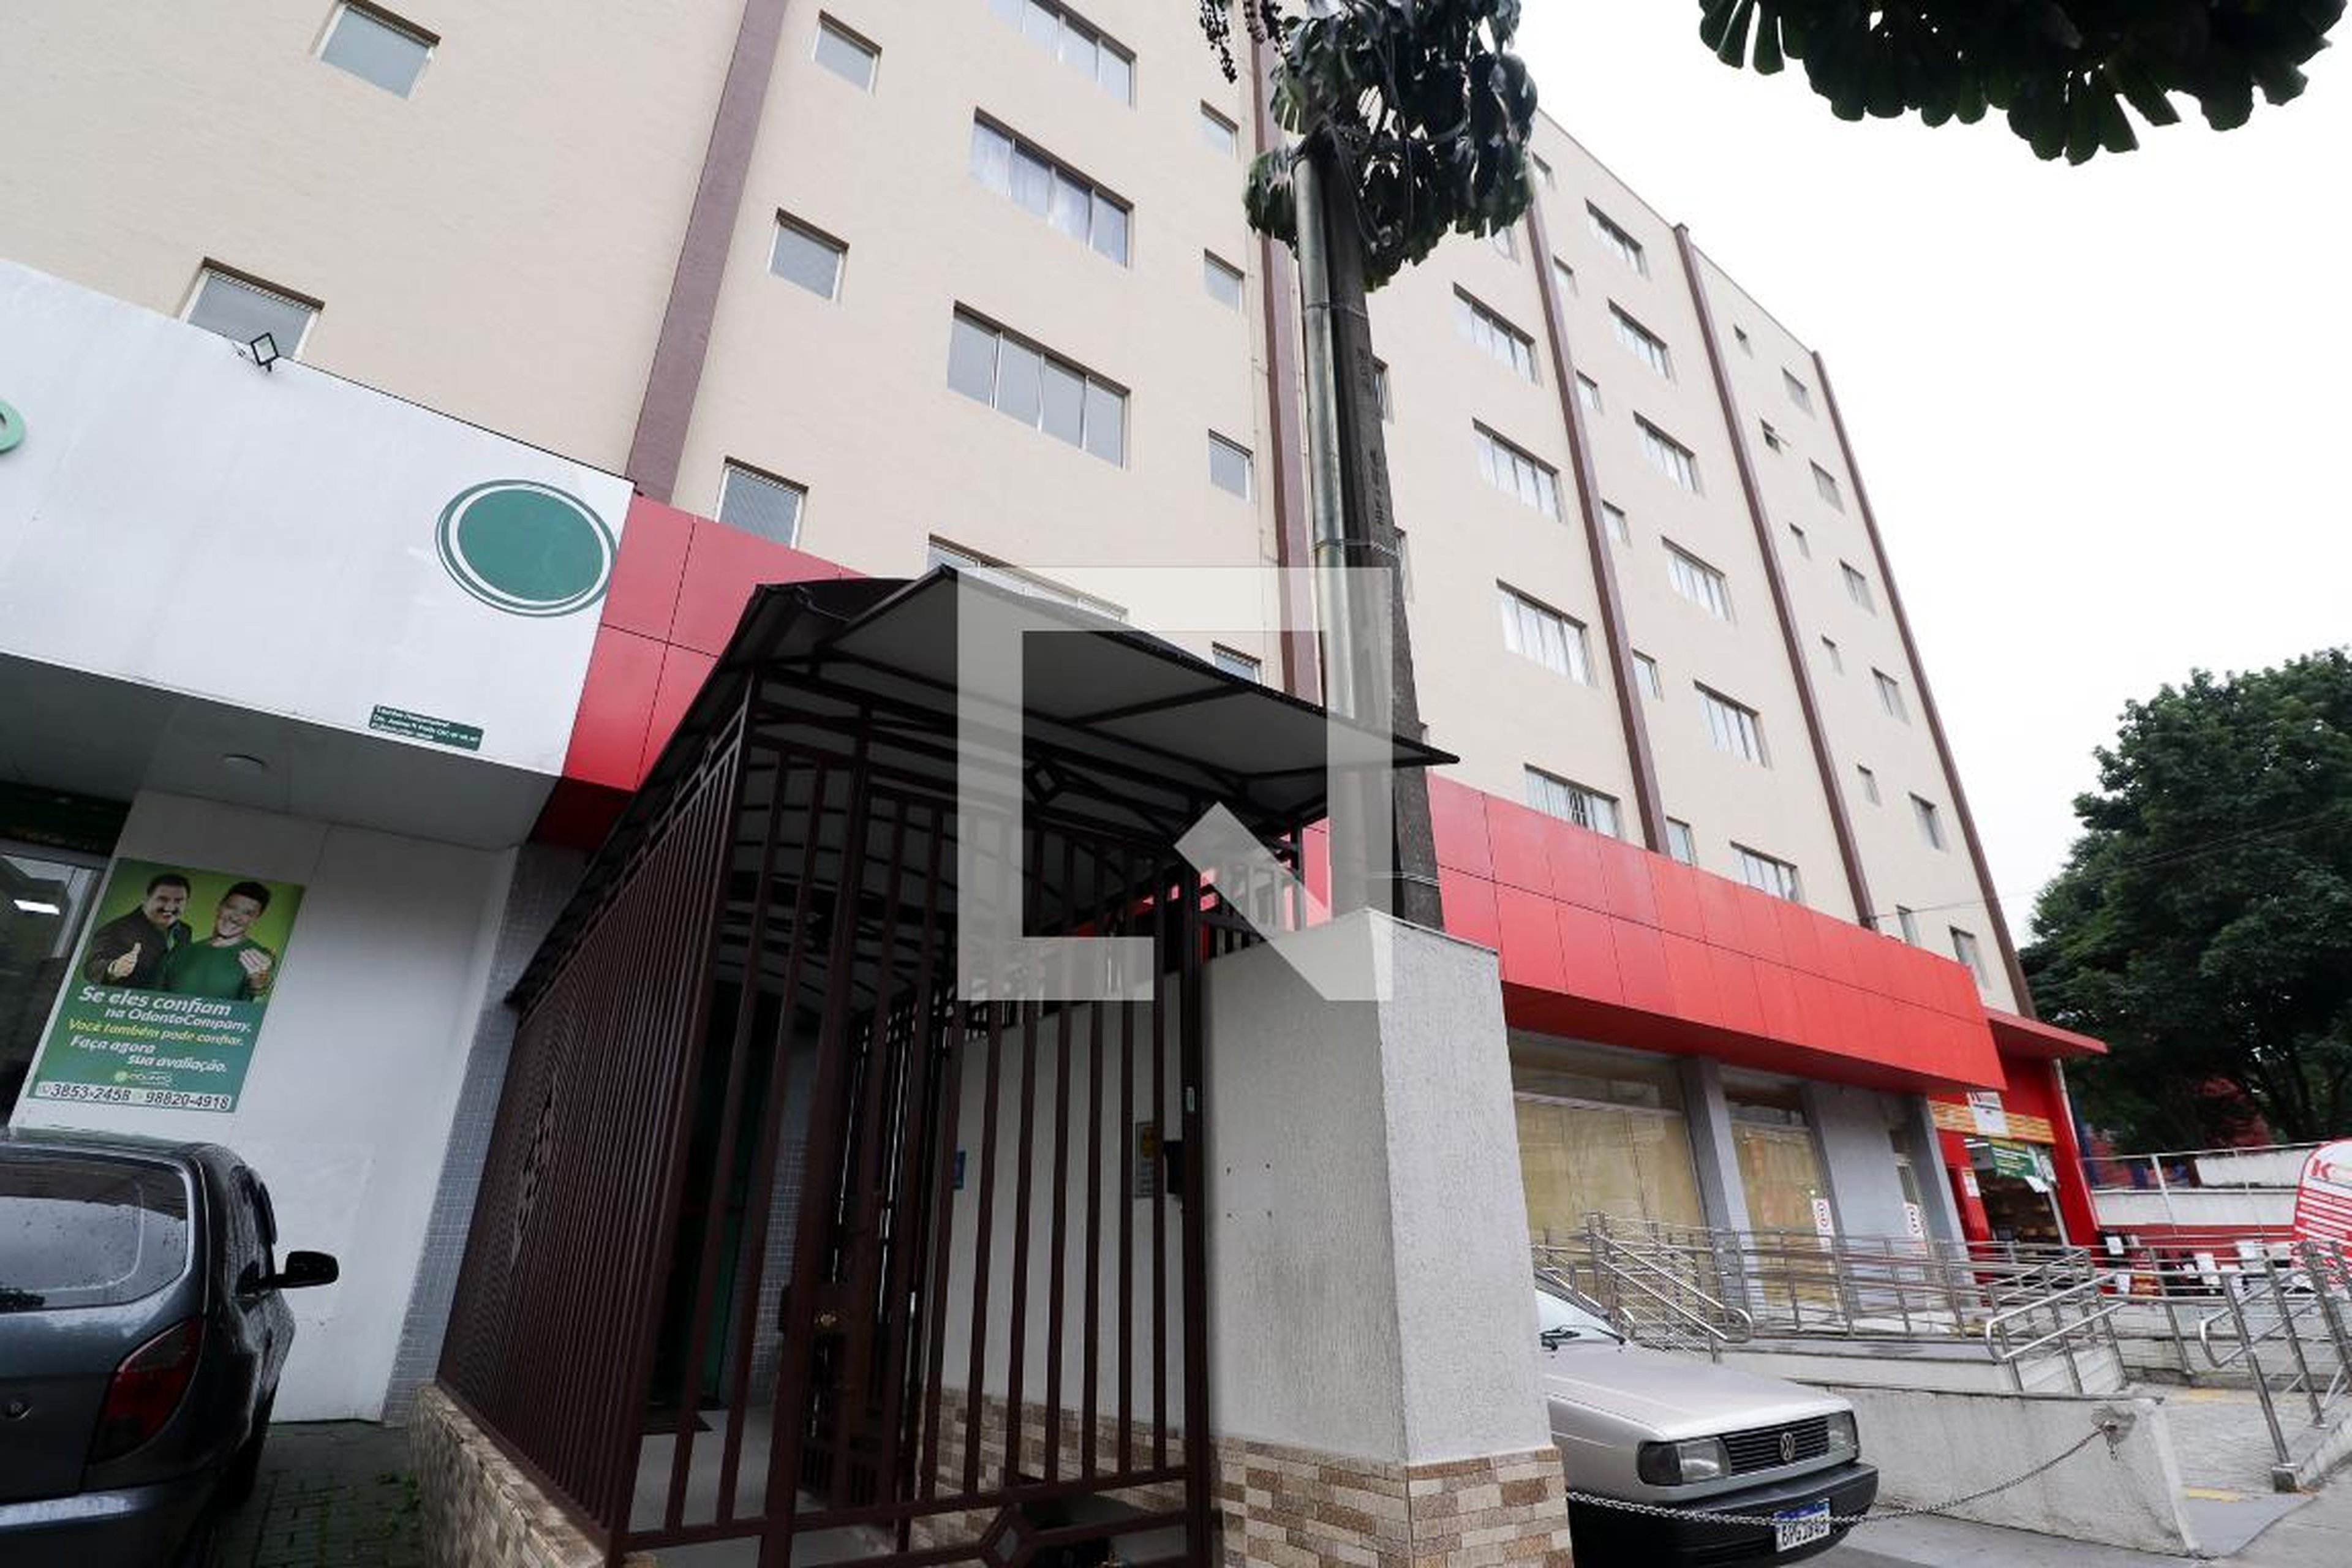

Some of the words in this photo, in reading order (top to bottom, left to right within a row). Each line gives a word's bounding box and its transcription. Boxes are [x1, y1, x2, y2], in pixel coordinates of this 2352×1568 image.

[78, 986, 105, 1003] Se
[108, 989, 148, 1007] eles
[153, 997, 232, 1016] confiam
[104, 1008, 126, 1019] na
[67, 1018, 100, 1033] Você
[103, 1023, 160, 1038] também
[160, 1030, 195, 1042] pode
[69, 1035, 107, 1050] Faça
[109, 1041, 156, 1054] agora
[127, 1054, 154, 1066] sua
[50, 1084, 132, 1102] 3853-2458
[145, 1091, 230, 1110] 98820-4918
